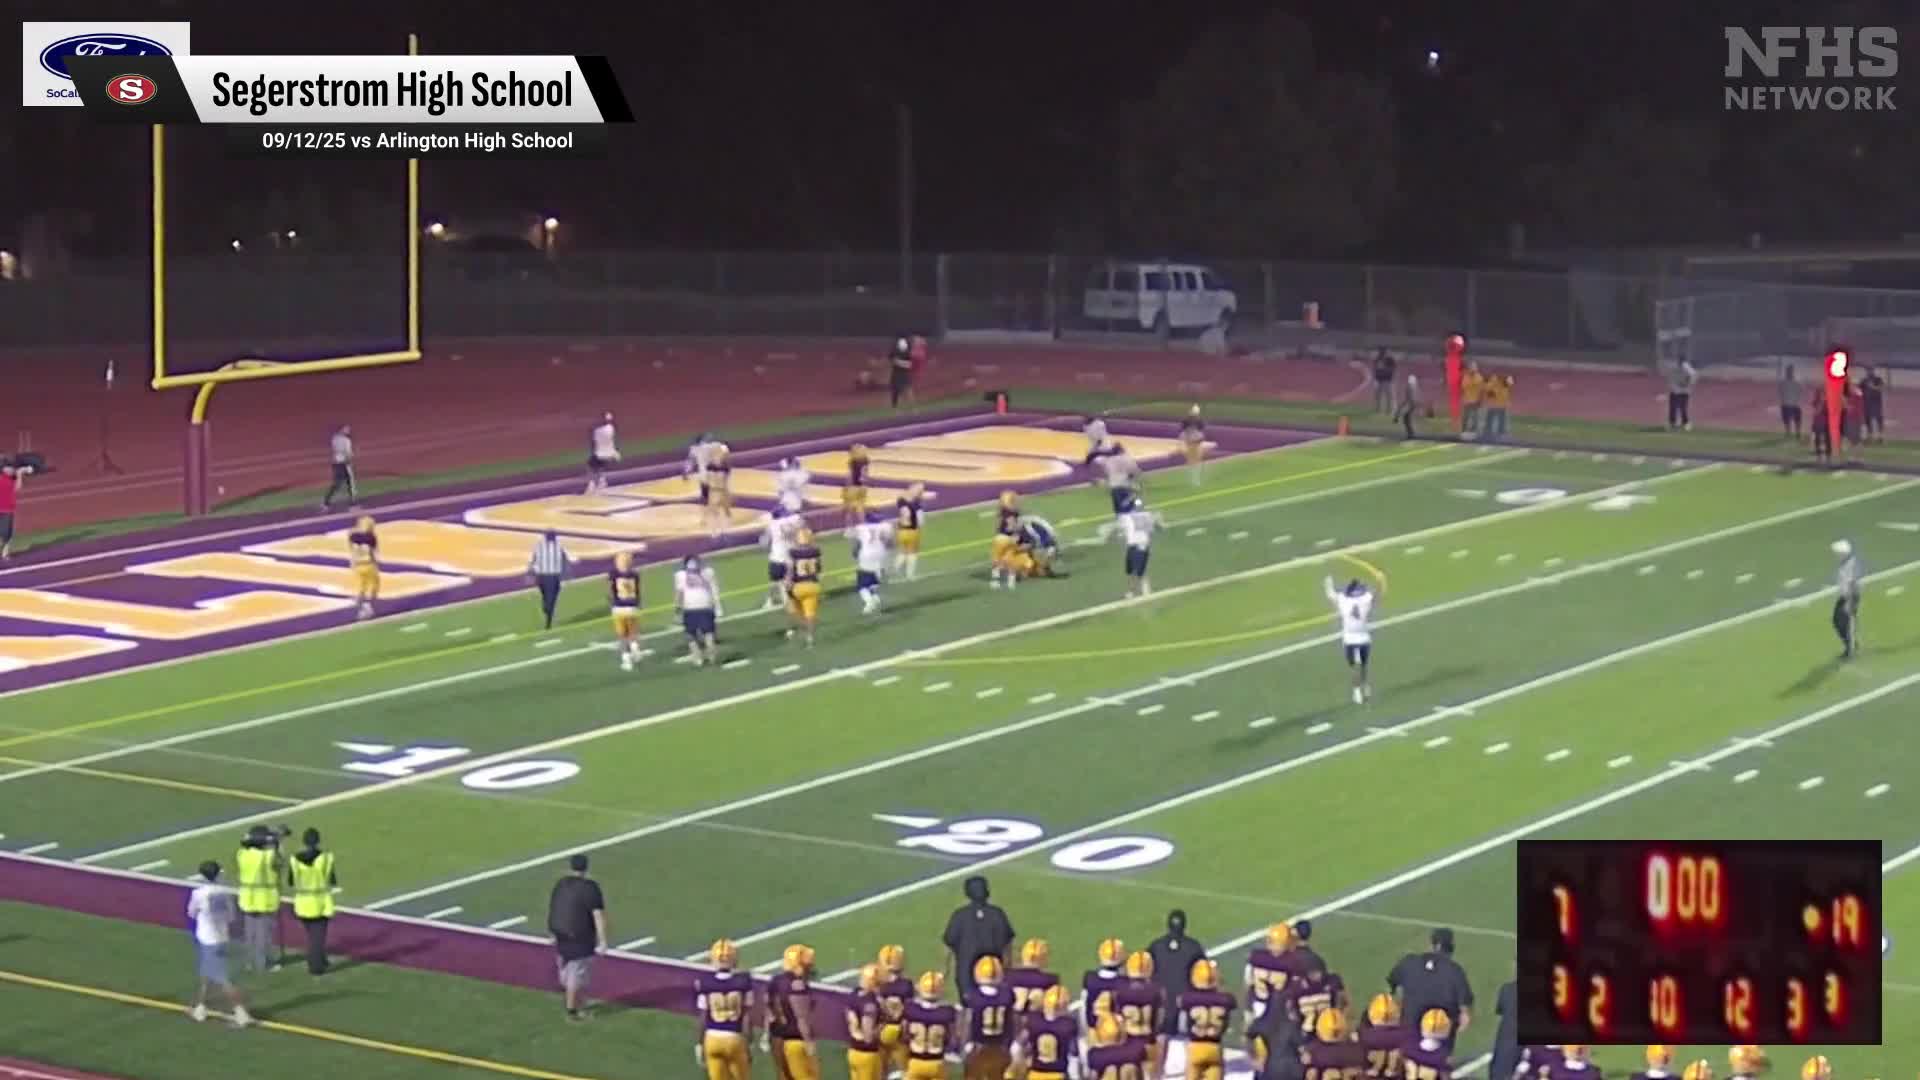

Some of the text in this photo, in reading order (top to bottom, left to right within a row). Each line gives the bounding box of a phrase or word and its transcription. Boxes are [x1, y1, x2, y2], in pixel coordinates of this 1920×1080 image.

[1553, 884, 1569, 936] 7
[1832, 895, 1860, 945] 19
[1553, 966, 1569, 1007] 3
[1588, 974, 1608, 1028] 2
[1649, 975, 1677, 1028] 10
[1725, 976, 1752, 1030] 12
[1786, 979, 1804, 1030] 3
[1824, 972, 1840, 1014] 3
